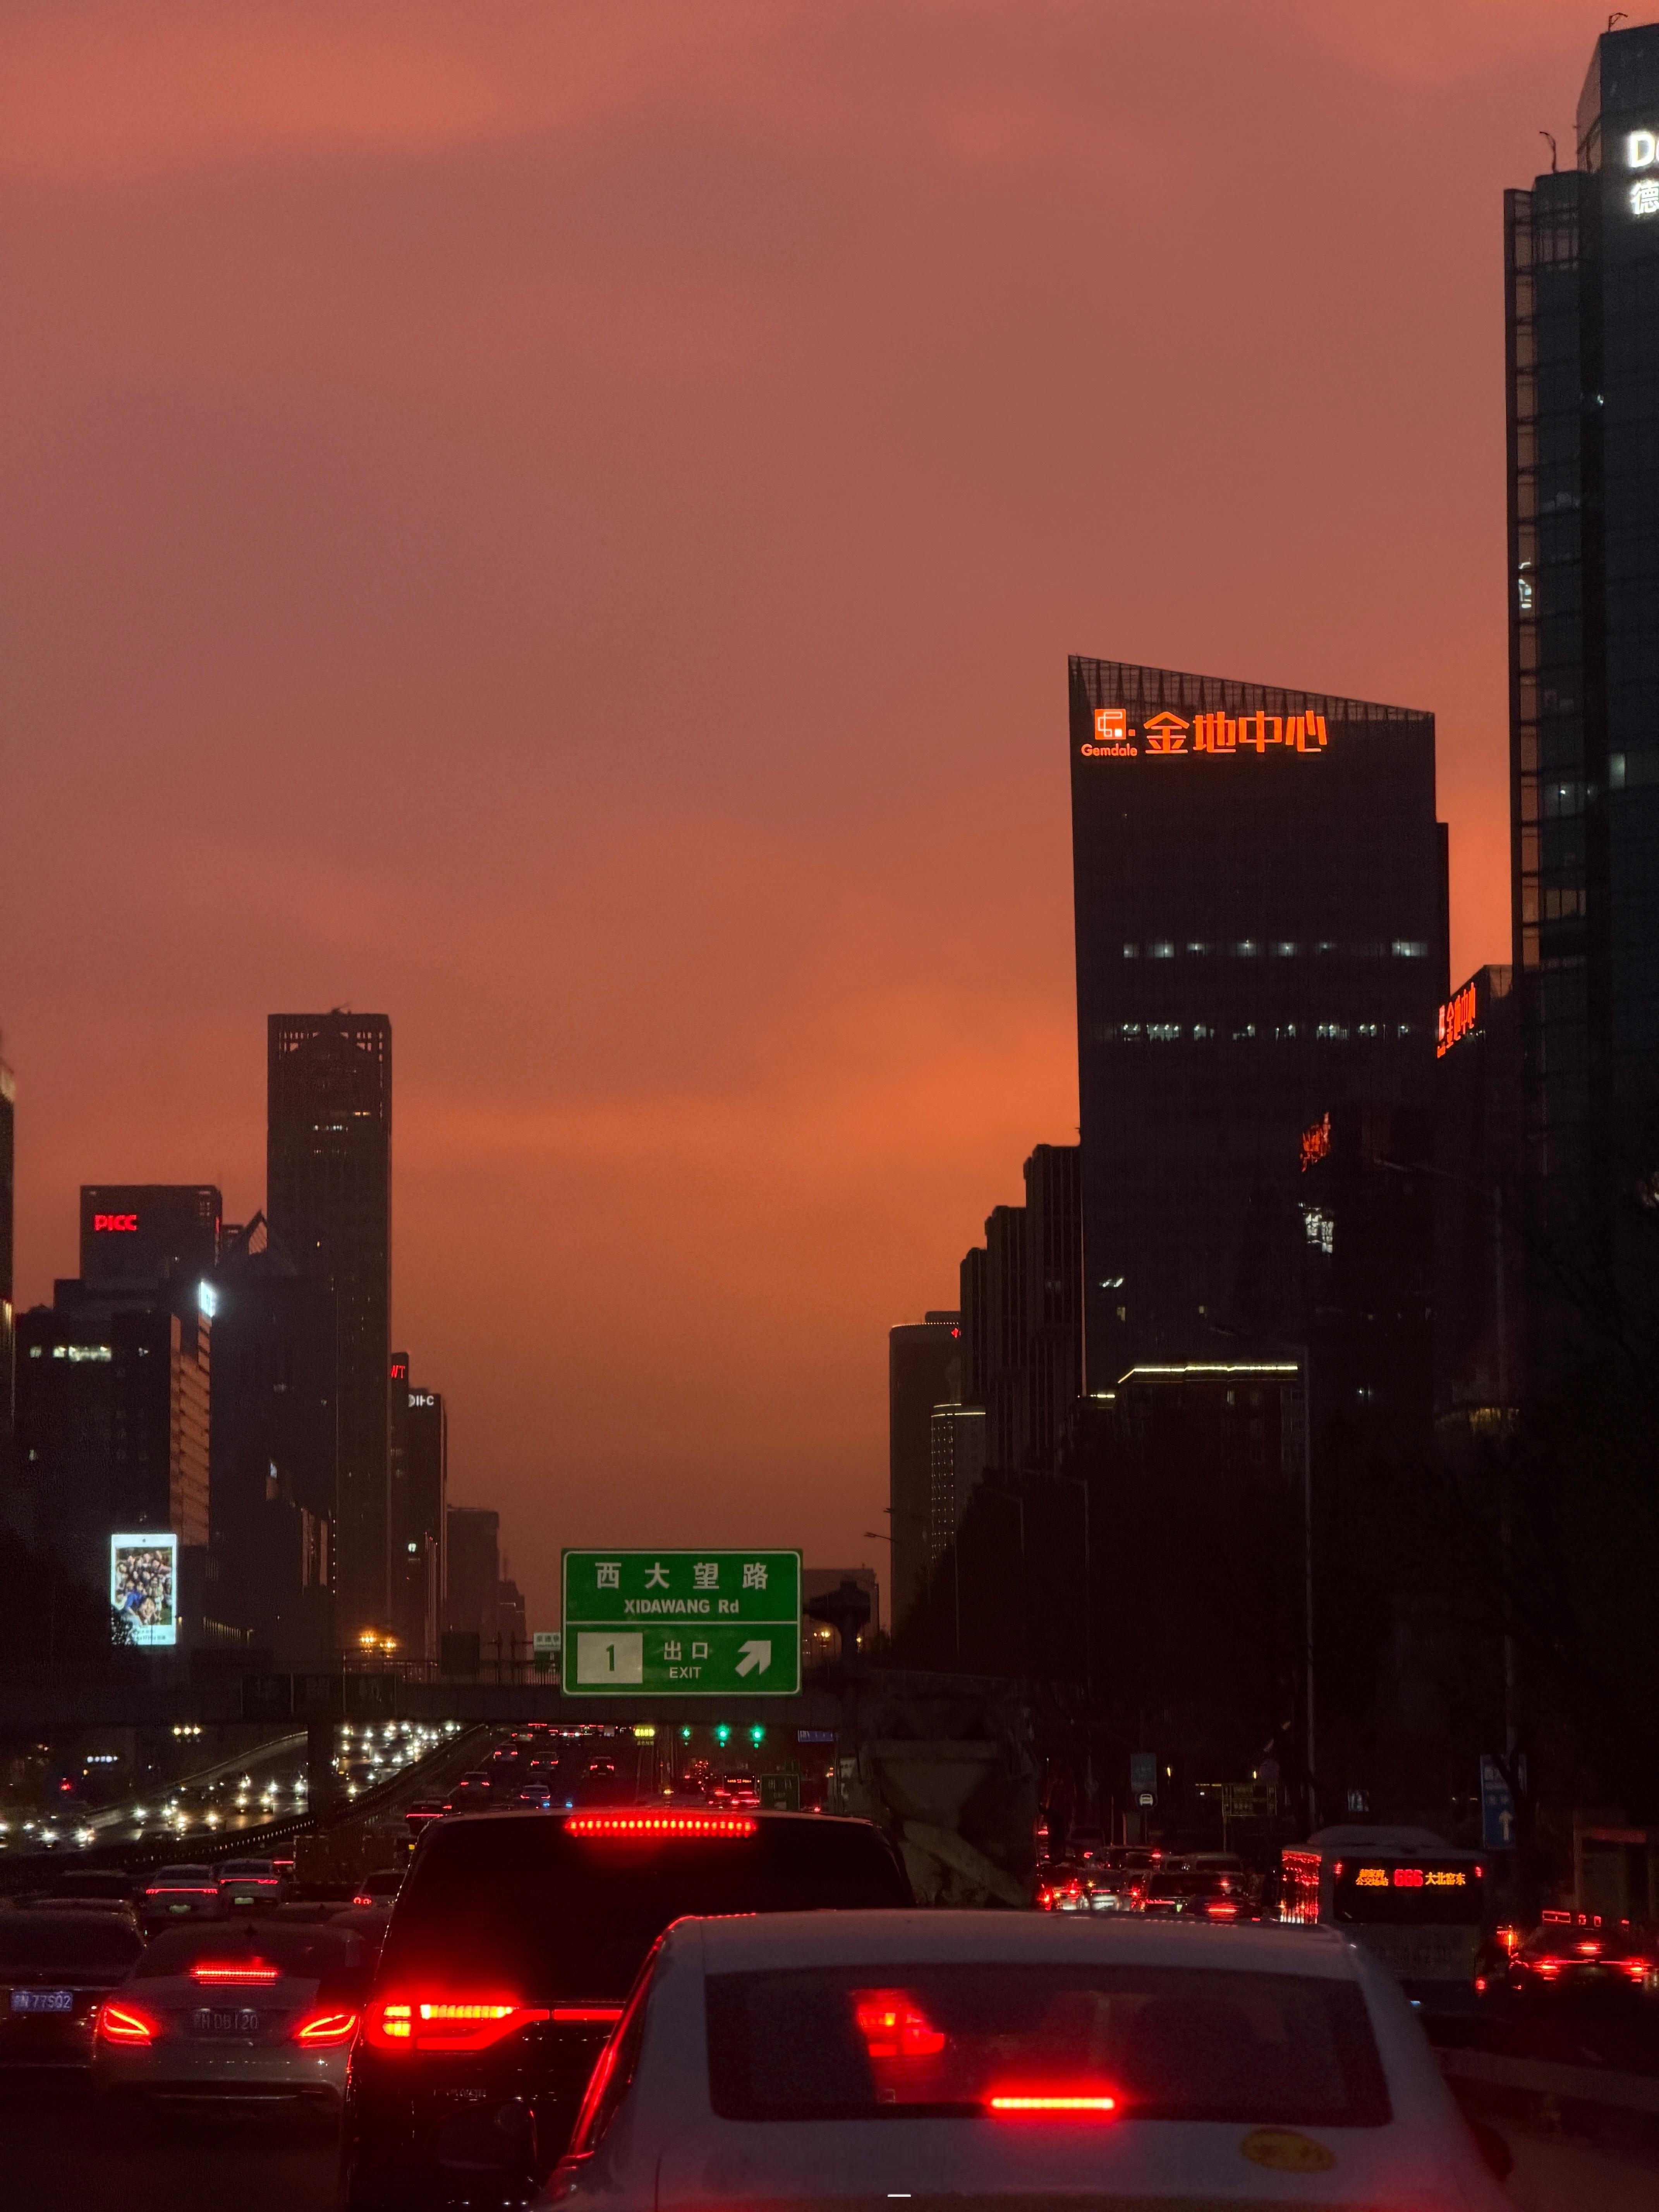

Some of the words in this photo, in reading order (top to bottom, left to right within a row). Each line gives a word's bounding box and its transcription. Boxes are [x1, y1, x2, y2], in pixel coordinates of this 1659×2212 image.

[1630, 134, 1659, 167] D
[1630, 180, 1659, 215] 德
[1144, 710, 1327, 754] 金地中心
[1081, 743, 1138, 756] Gemdale
[95, 1214, 137, 1231] PICC
[595, 1562, 768, 1590] 西大望路
[624, 1599, 710, 1614] XIDAWANG
[718, 1599, 739, 1613] Rd
[606, 1644, 615, 1672] 1
[664, 1640, 708, 1661] 出口
[669, 1666, 702, 1679] EXIT
[1395, 1869, 1424, 1886] 666
